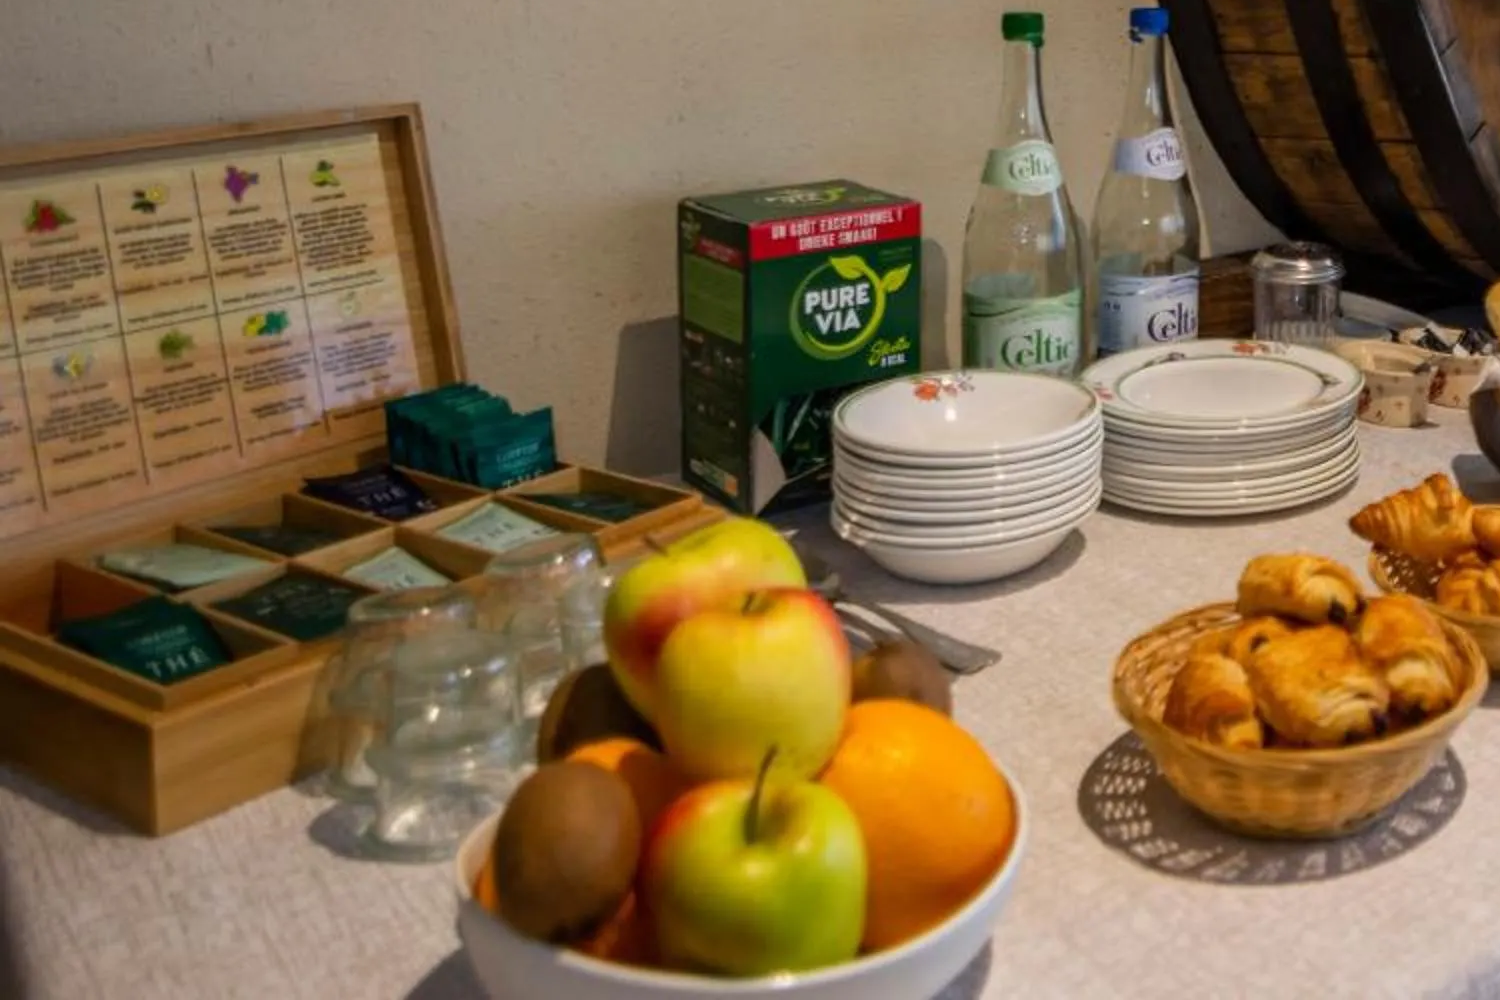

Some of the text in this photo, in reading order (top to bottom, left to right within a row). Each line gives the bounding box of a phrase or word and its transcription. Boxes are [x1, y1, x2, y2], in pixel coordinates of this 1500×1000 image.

[804, 282, 871, 315] PURE
[815, 307, 862, 335] VIA
[1001, 328, 1074, 371] Celtic
